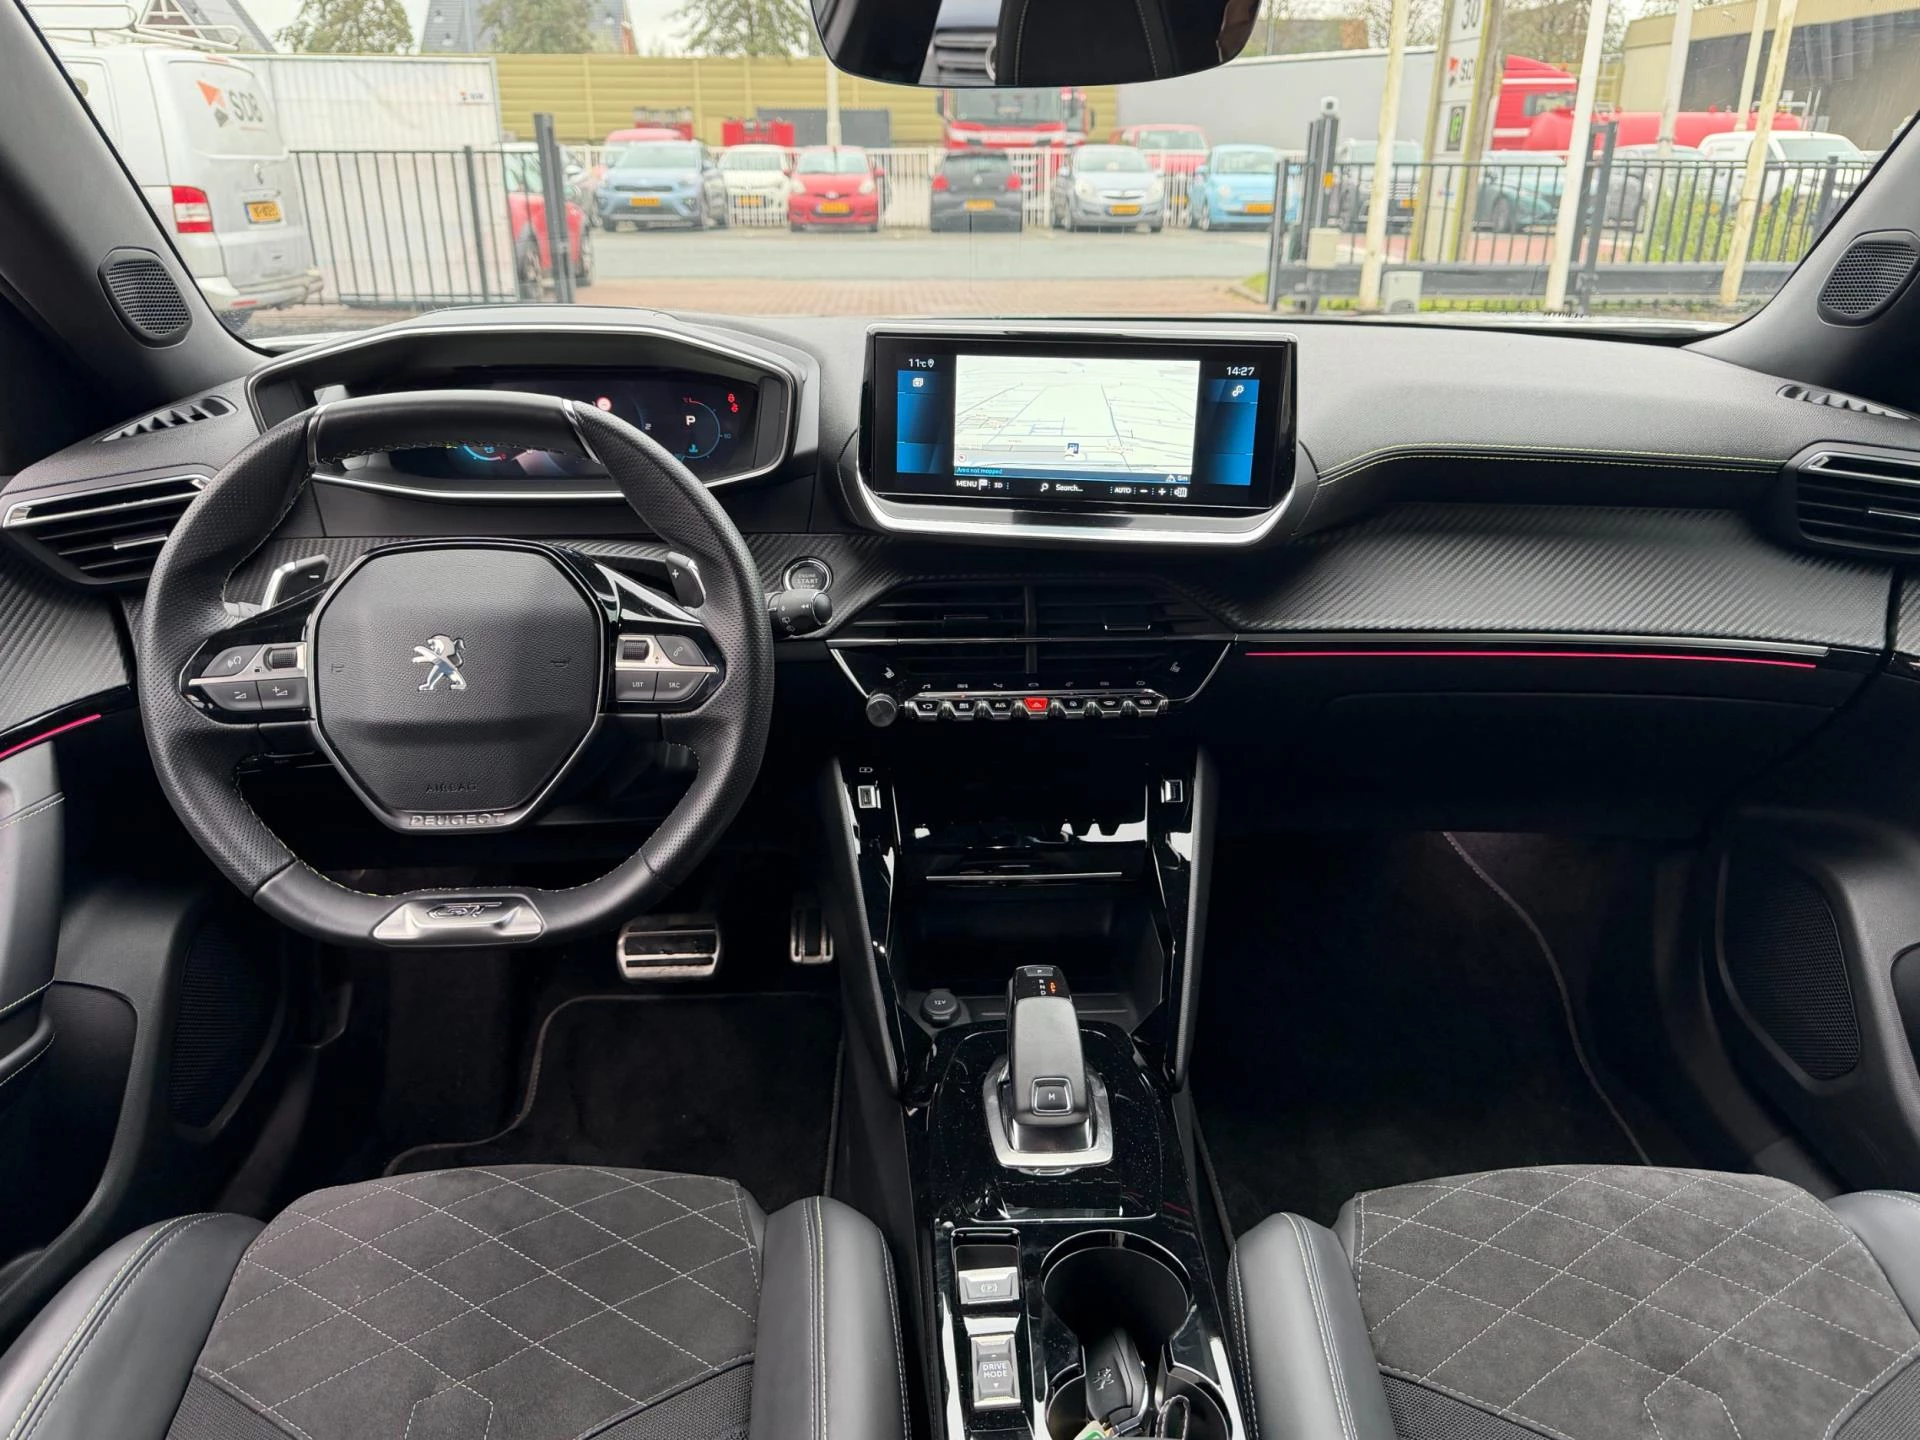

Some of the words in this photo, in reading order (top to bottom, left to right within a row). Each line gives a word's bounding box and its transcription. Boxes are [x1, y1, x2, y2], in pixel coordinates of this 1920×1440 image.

[1226, 366, 1255, 376] 14:27
[685, 415, 696, 426] P
[956, 479, 978, 488] MENU
[409, 812, 505, 827] PEUGEOT
[982, 1362, 1007, 1371] DRIVE
[983, 1370, 1008, 1379] MODE
